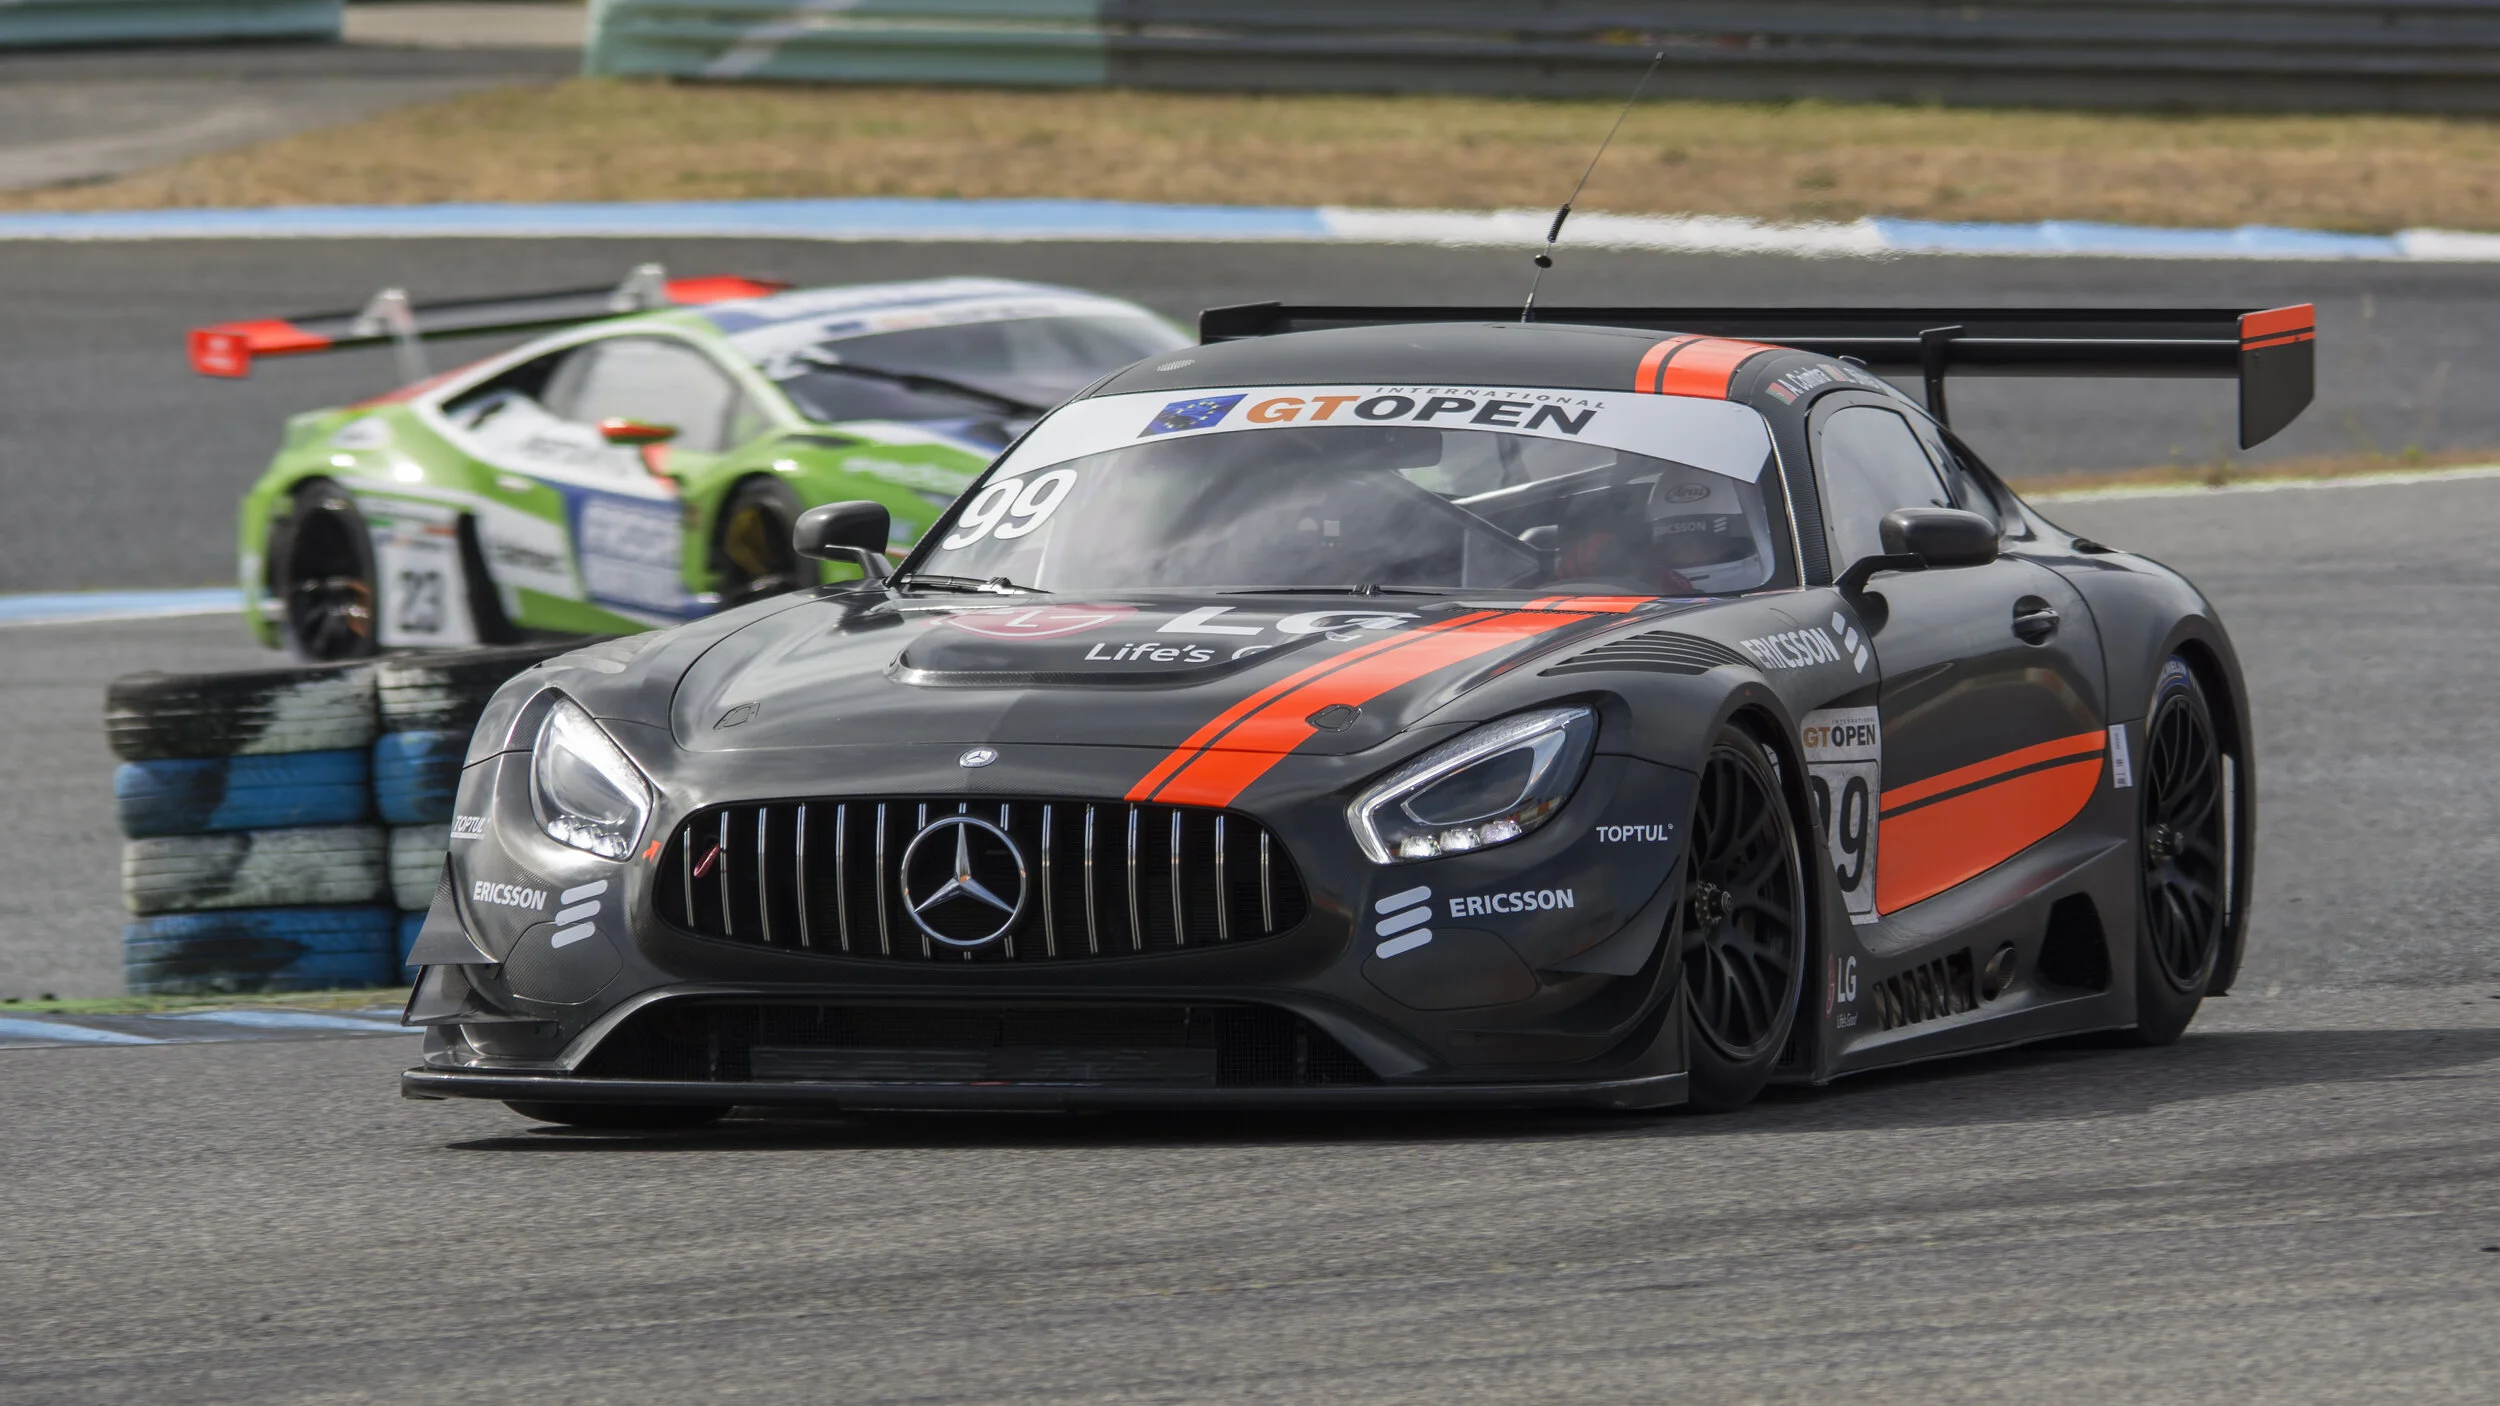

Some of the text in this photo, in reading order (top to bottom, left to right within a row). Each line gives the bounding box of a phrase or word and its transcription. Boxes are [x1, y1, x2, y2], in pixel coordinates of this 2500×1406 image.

[1375, 386, 1607, 410] INTERNATIONAL
[942, 468, 1078, 551] 99
[1155, 606, 1423, 637] LG
[1083, 642, 1216, 663] Life's
[1739, 627, 1841, 669] ERICSSON
[472, 880, 548, 911] ERICSSON
[1449, 888, 1575, 918] ERICSSON
[1836, 955, 1857, 1003] LG
